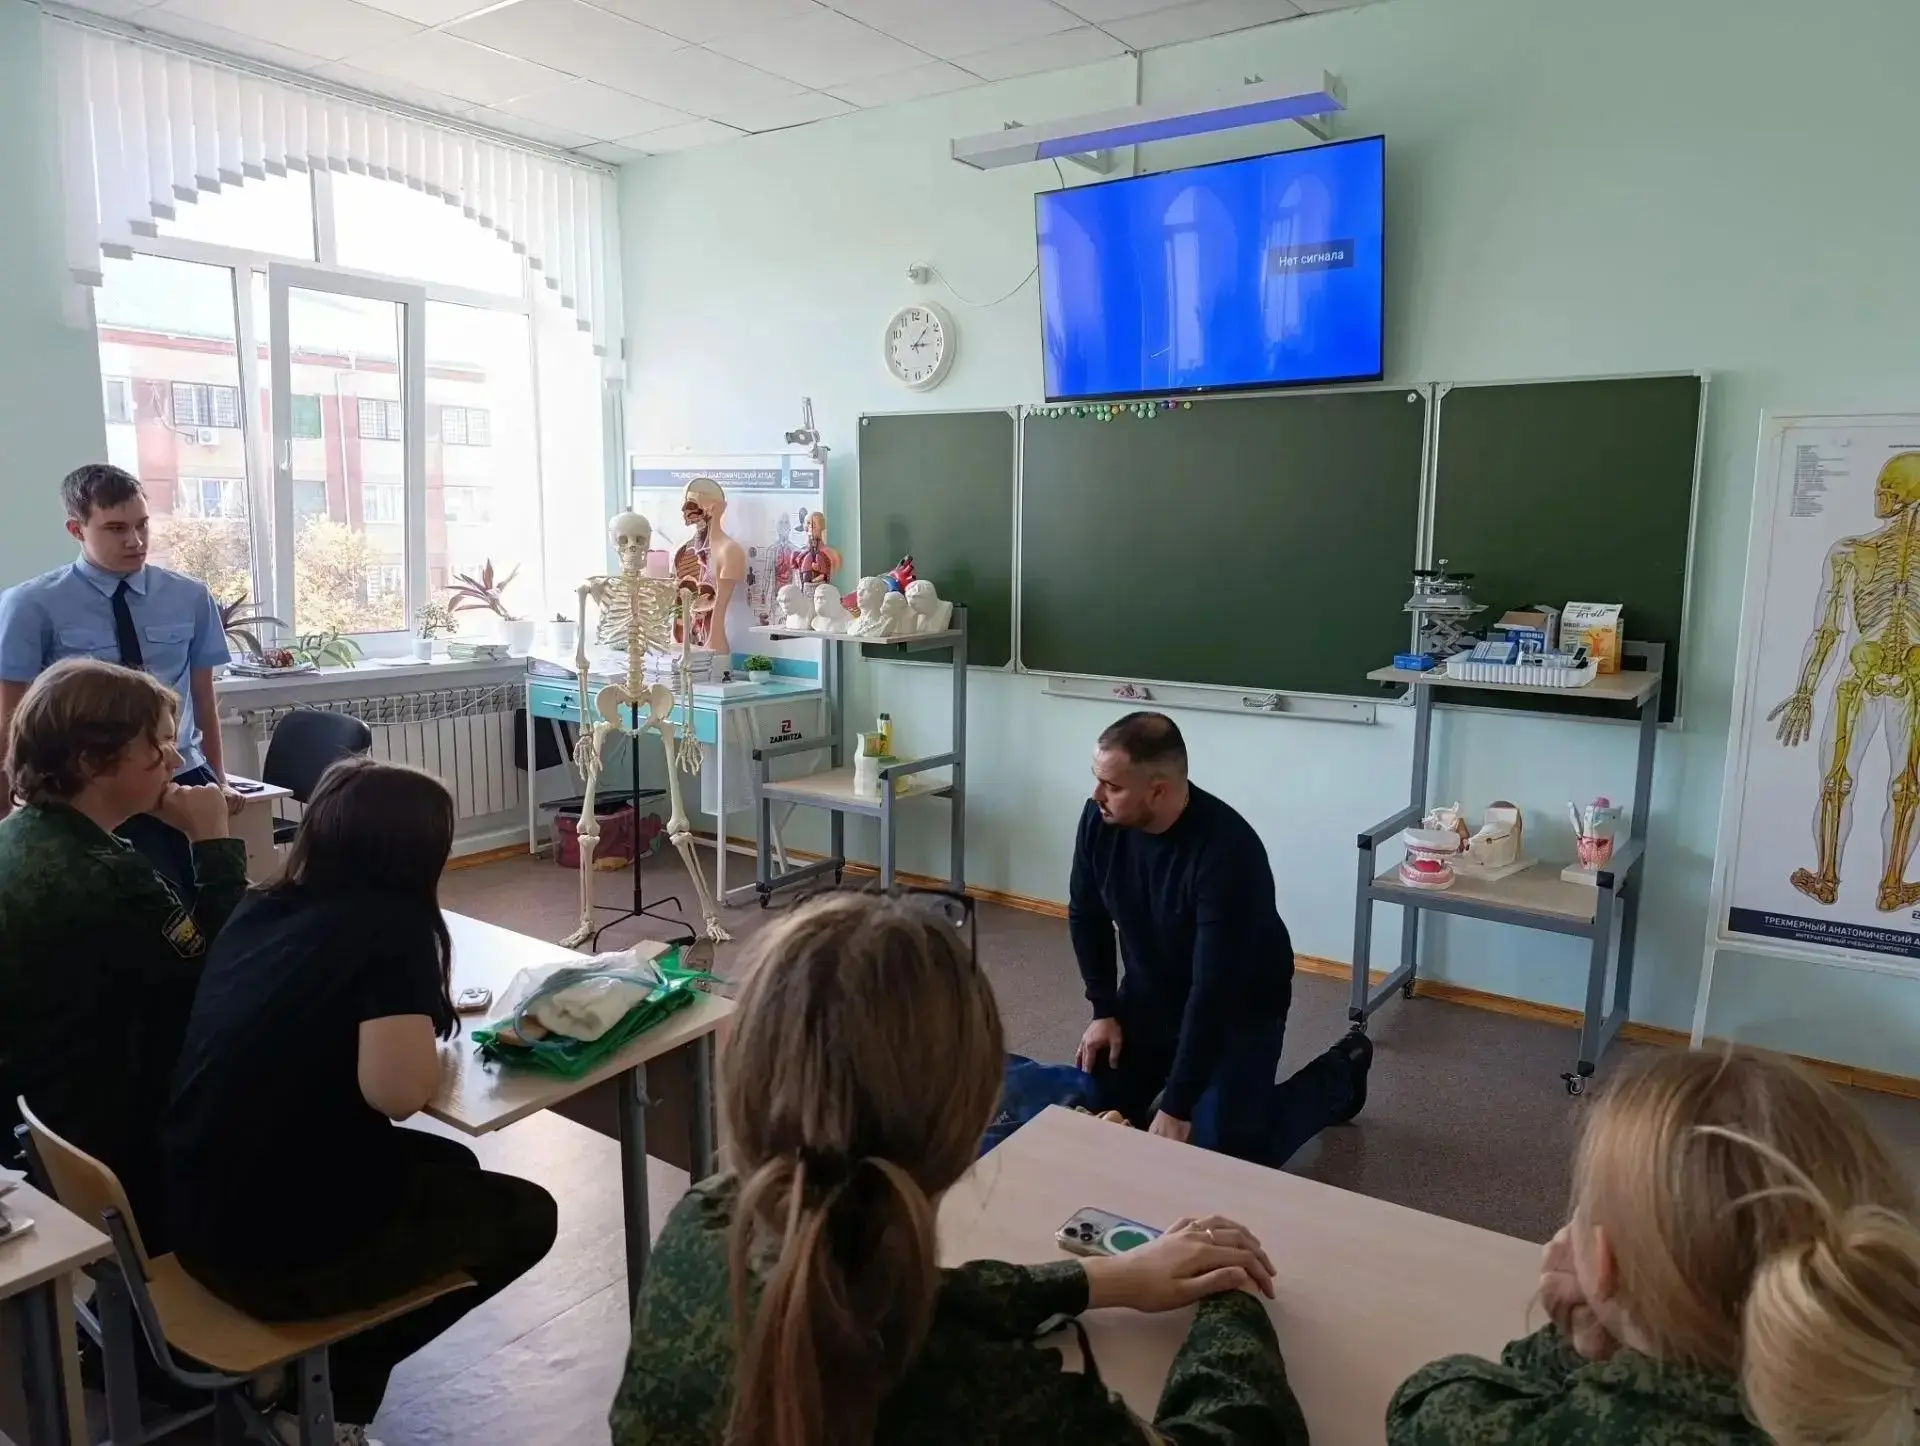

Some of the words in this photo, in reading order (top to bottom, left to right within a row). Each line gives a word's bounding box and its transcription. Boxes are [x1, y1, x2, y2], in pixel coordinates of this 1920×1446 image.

[1279, 255, 1298, 267] Нет
[1300, 250, 1344, 264] сигнала
[911, 311, 920, 321] 12
[901, 318, 907, 328] 11
[933, 322, 939, 332] 2
[893, 329, 901, 340] 10
[769, 732, 803, 744] ZARNITZA
[1764, 915, 1827, 932] ТРЕХМЕРНЫЙ
[1828, 926, 1912, 945] АНАТОМИЧЕСКИЙ
